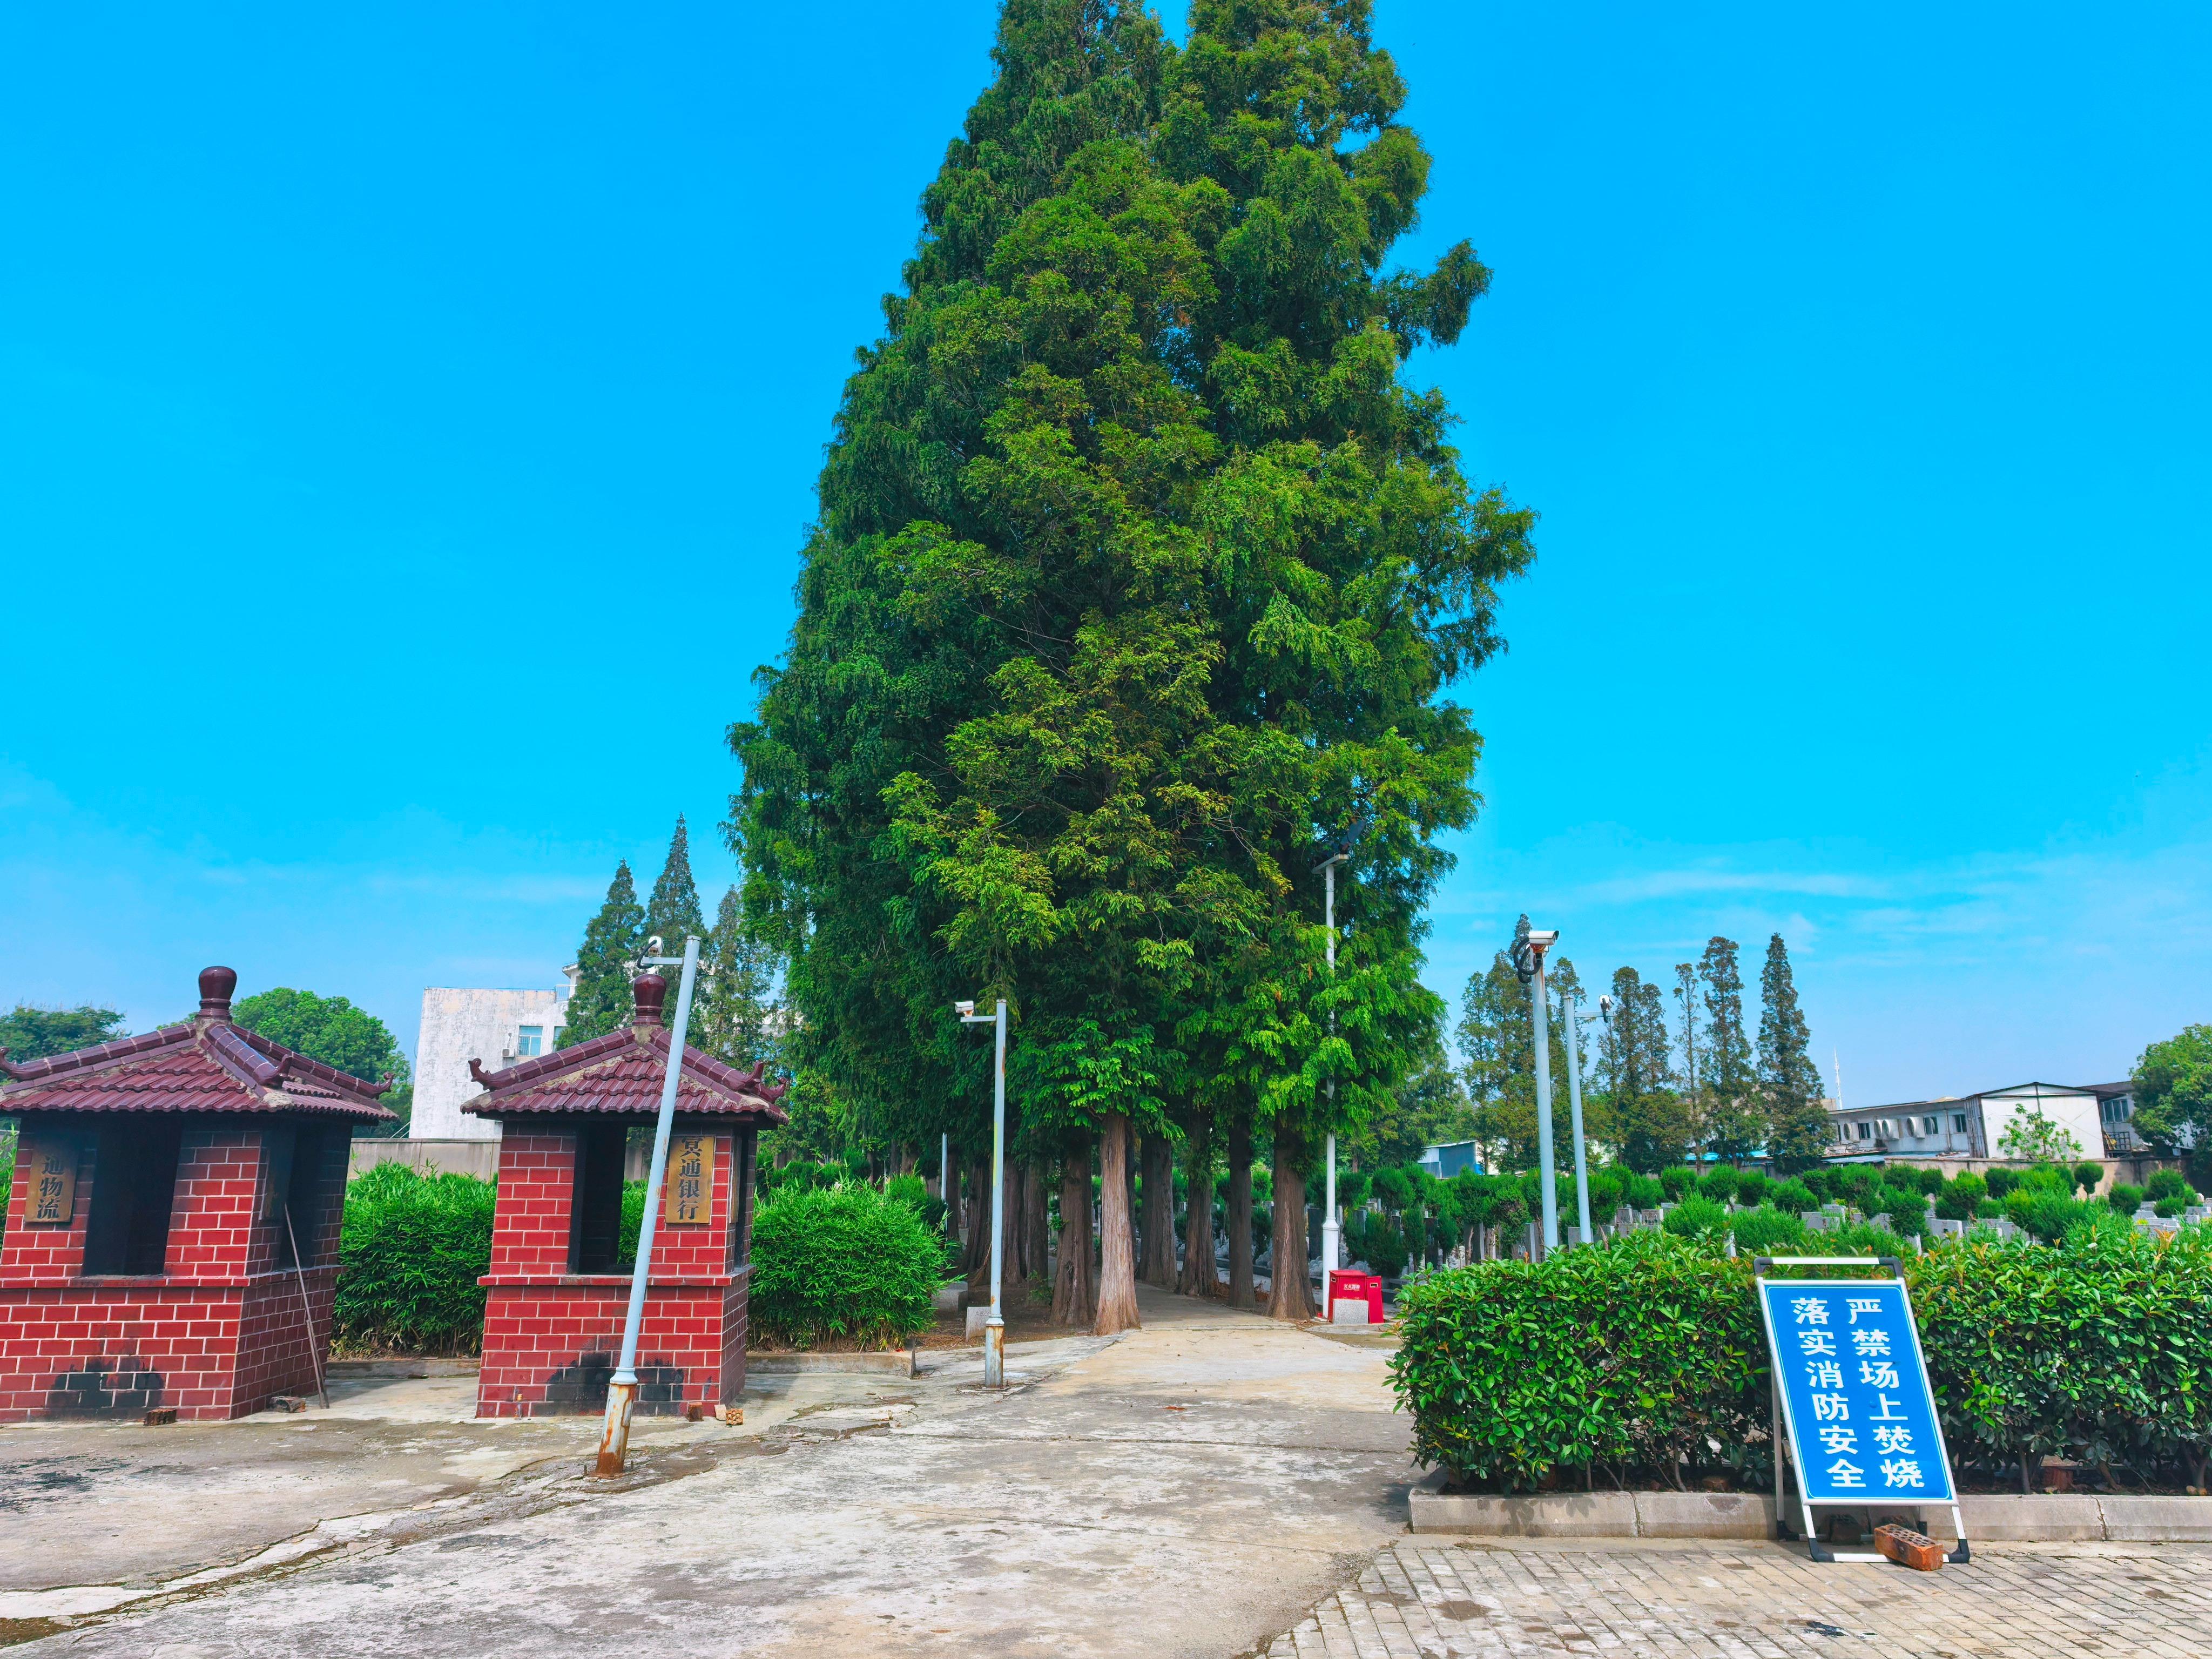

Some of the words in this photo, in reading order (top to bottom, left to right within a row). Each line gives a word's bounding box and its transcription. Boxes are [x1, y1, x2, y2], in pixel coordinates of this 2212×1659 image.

[36, 1154, 65, 1219] 通物流
[677, 1137, 703, 1220] 冥通银行
[1790, 1297, 1867, 1488] 落实消防安全
[1845, 1298, 1925, 1489] 严禁场上焚烧
